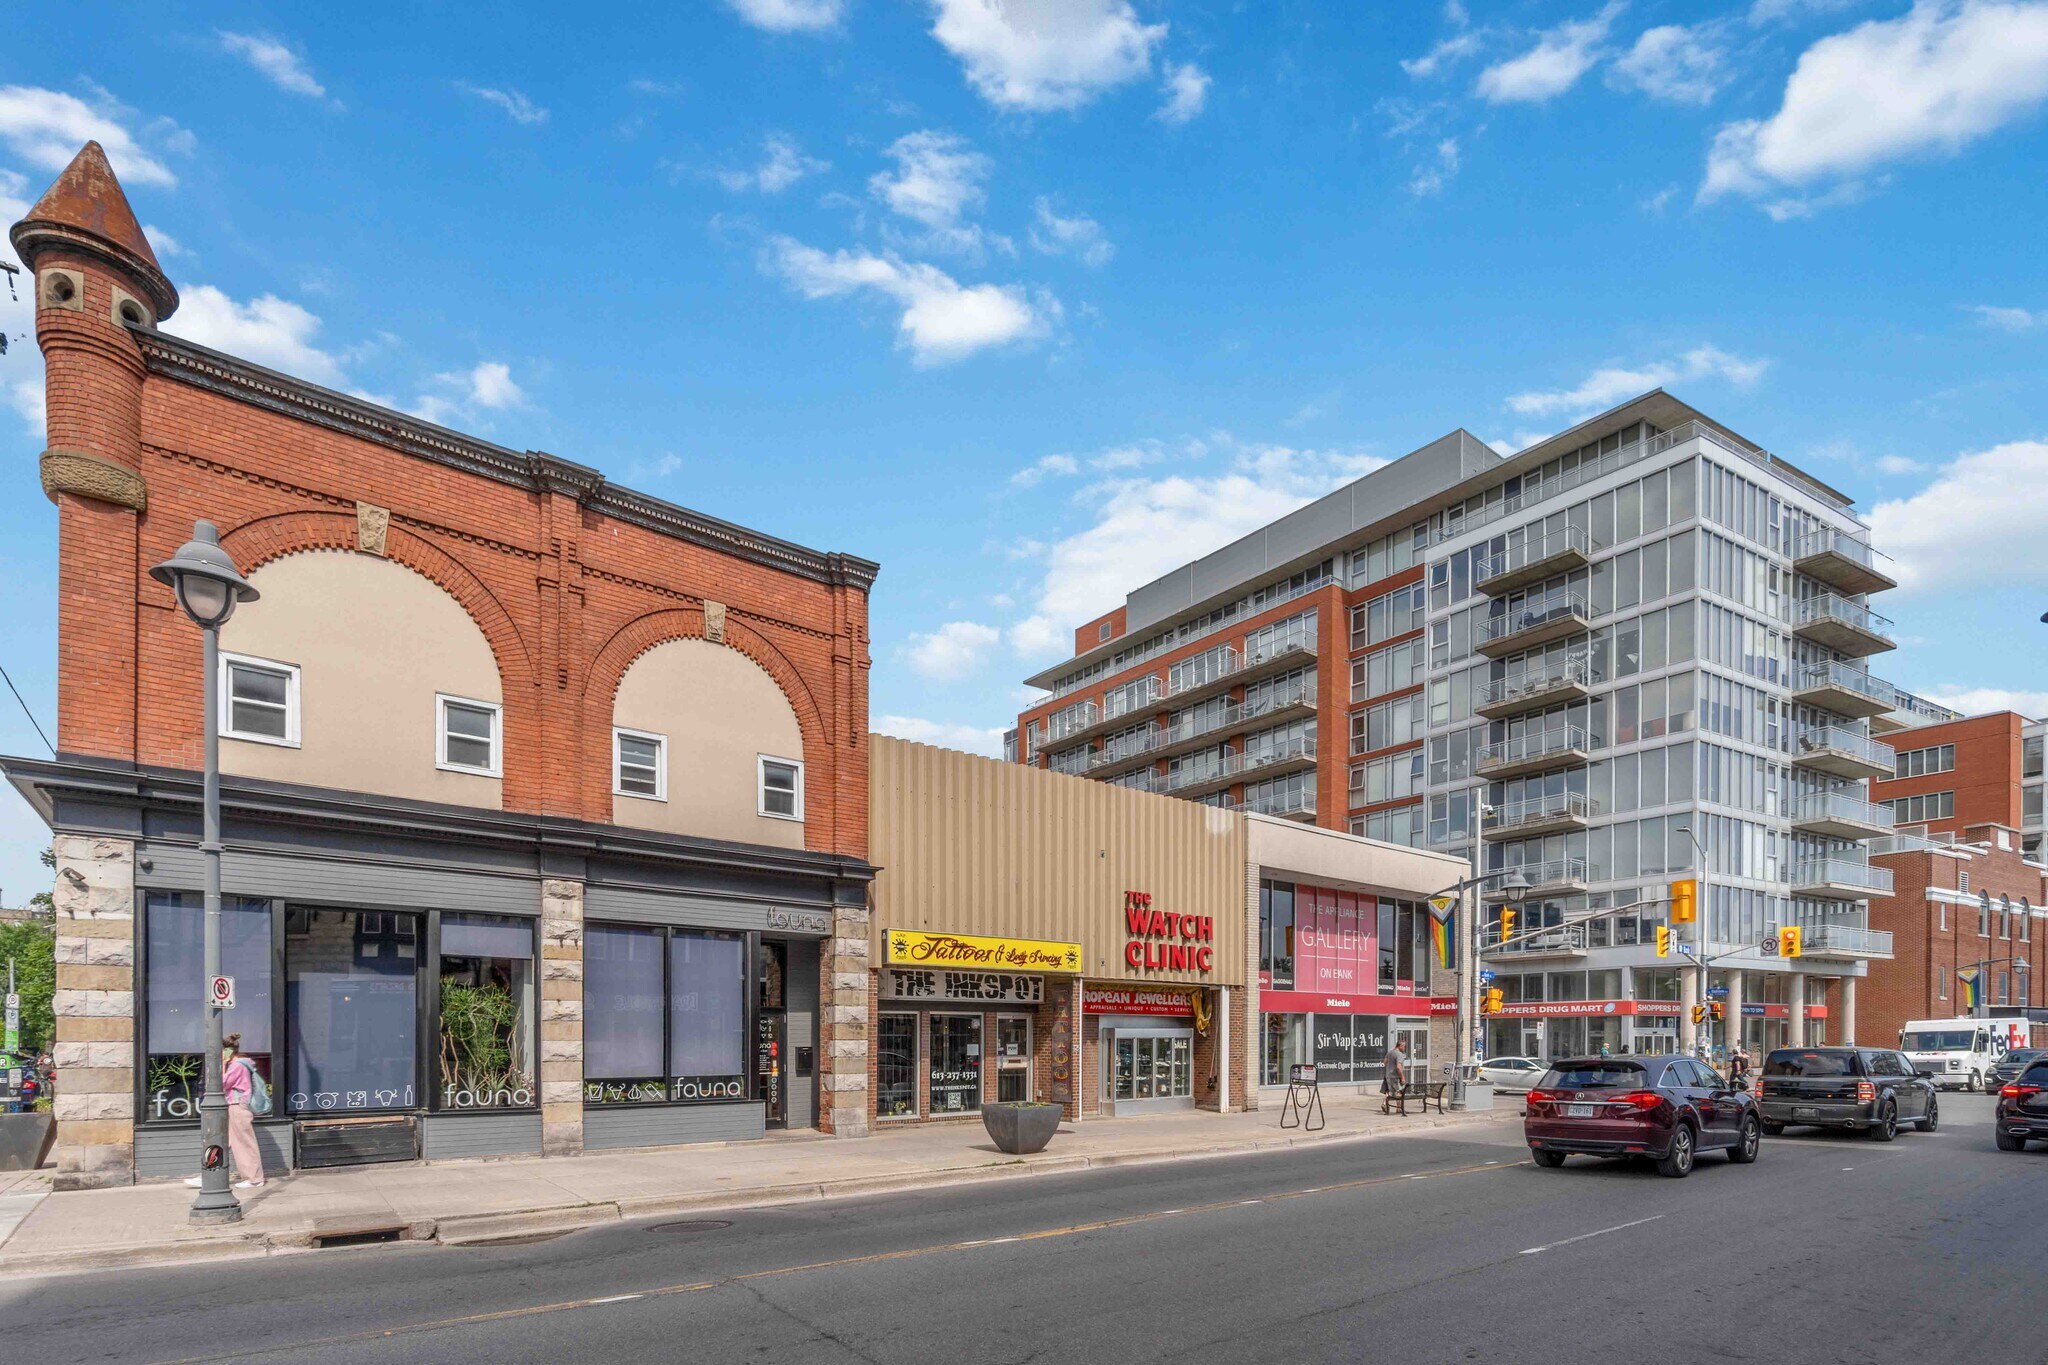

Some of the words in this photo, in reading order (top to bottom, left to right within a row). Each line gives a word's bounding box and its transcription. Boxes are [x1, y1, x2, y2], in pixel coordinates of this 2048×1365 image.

[768, 906, 827, 932] fauna
[1125, 907, 1214, 942] WATCH
[911, 935, 994, 962] Tattoos
[1301, 925, 1371, 952] GALLERY
[1125, 941, 1214, 972] CLINIC
[890, 969, 936, 997] THE
[945, 972, 1043, 1000] INKSPOT
[1320, 967, 1332, 979] ON
[1333, 968, 1353, 980] BANK
[1326, 999, 1351, 1007] Miele
[1539, 1005, 1569, 1013] DRUG
[1571, 1004, 1603, 1012] MART
[1637, 1004, 1672, 1012] SHOPPERS
[1317, 1033, 1331, 1049] Sir
[1358, 1033, 1367, 1048] A
[1367, 1033, 1384, 1047] Lot
[1989, 1023, 2026, 1056] FedEx
[931, 1070, 977, 1081] 613-237-1331
[444, 1084, 531, 1107] fauna
[675, 1077, 741, 1098] fauna
